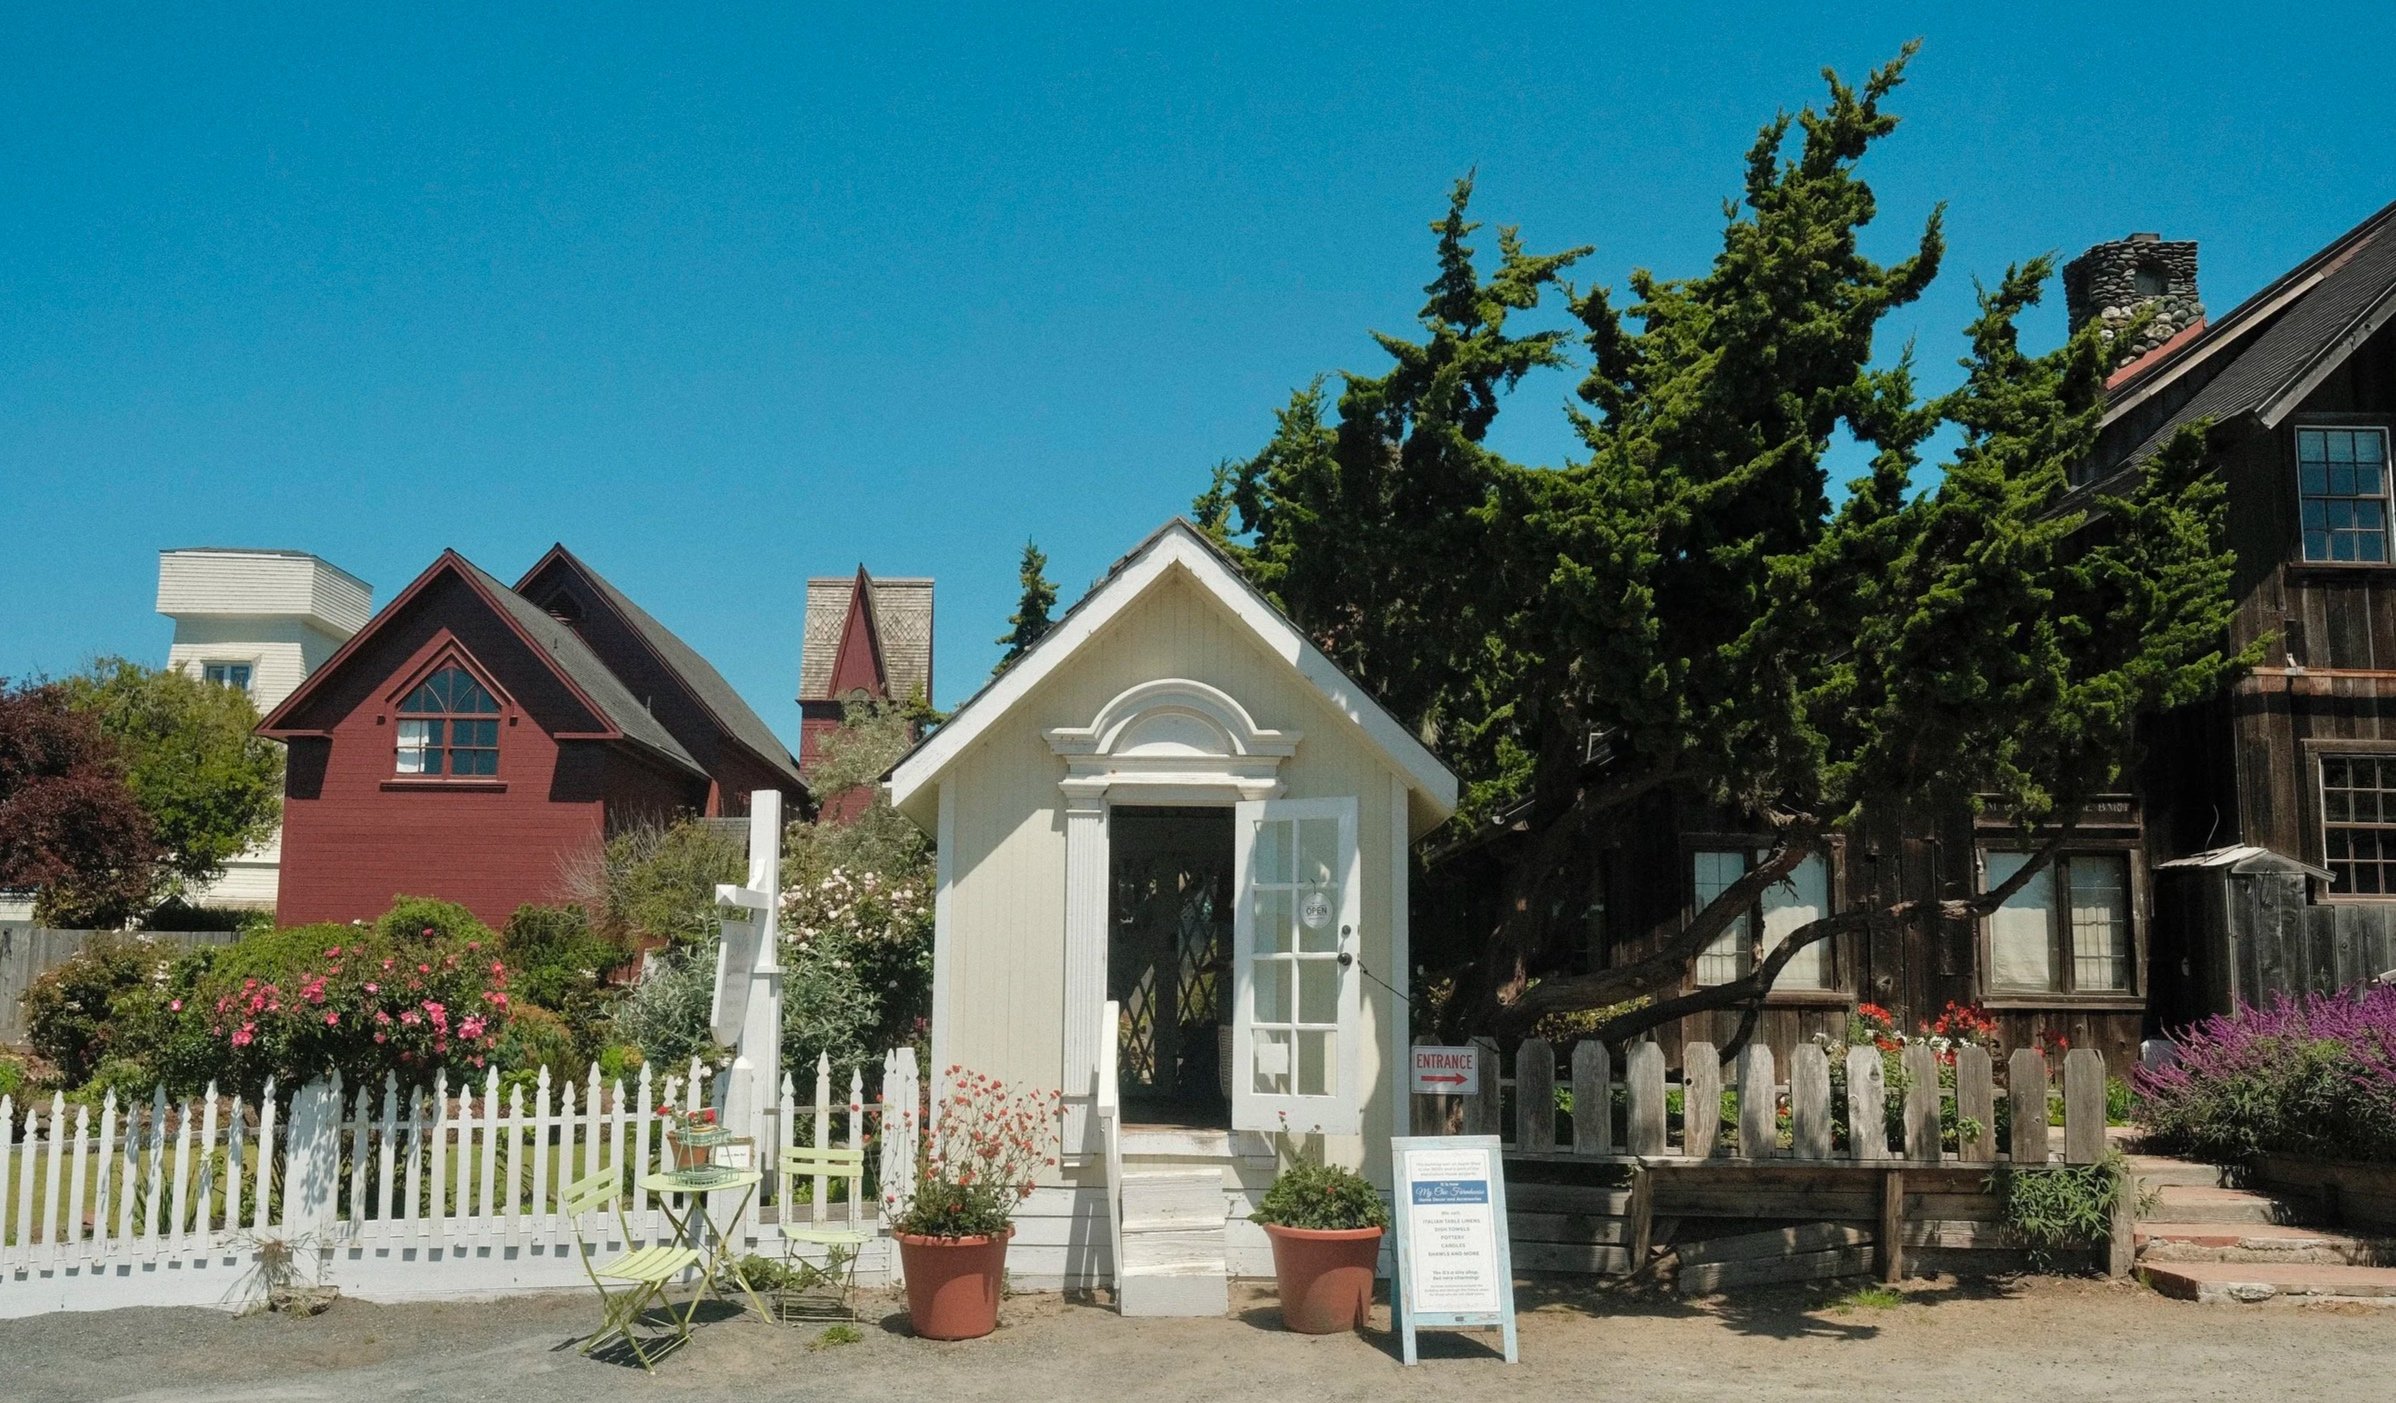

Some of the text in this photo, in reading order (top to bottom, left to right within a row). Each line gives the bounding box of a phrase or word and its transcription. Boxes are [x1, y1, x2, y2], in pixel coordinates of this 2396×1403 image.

[1306, 906, 1328, 915] OPEN
[1417, 1054, 1473, 1069] ENTRANCE
[1415, 1187, 1433, 1198] My
